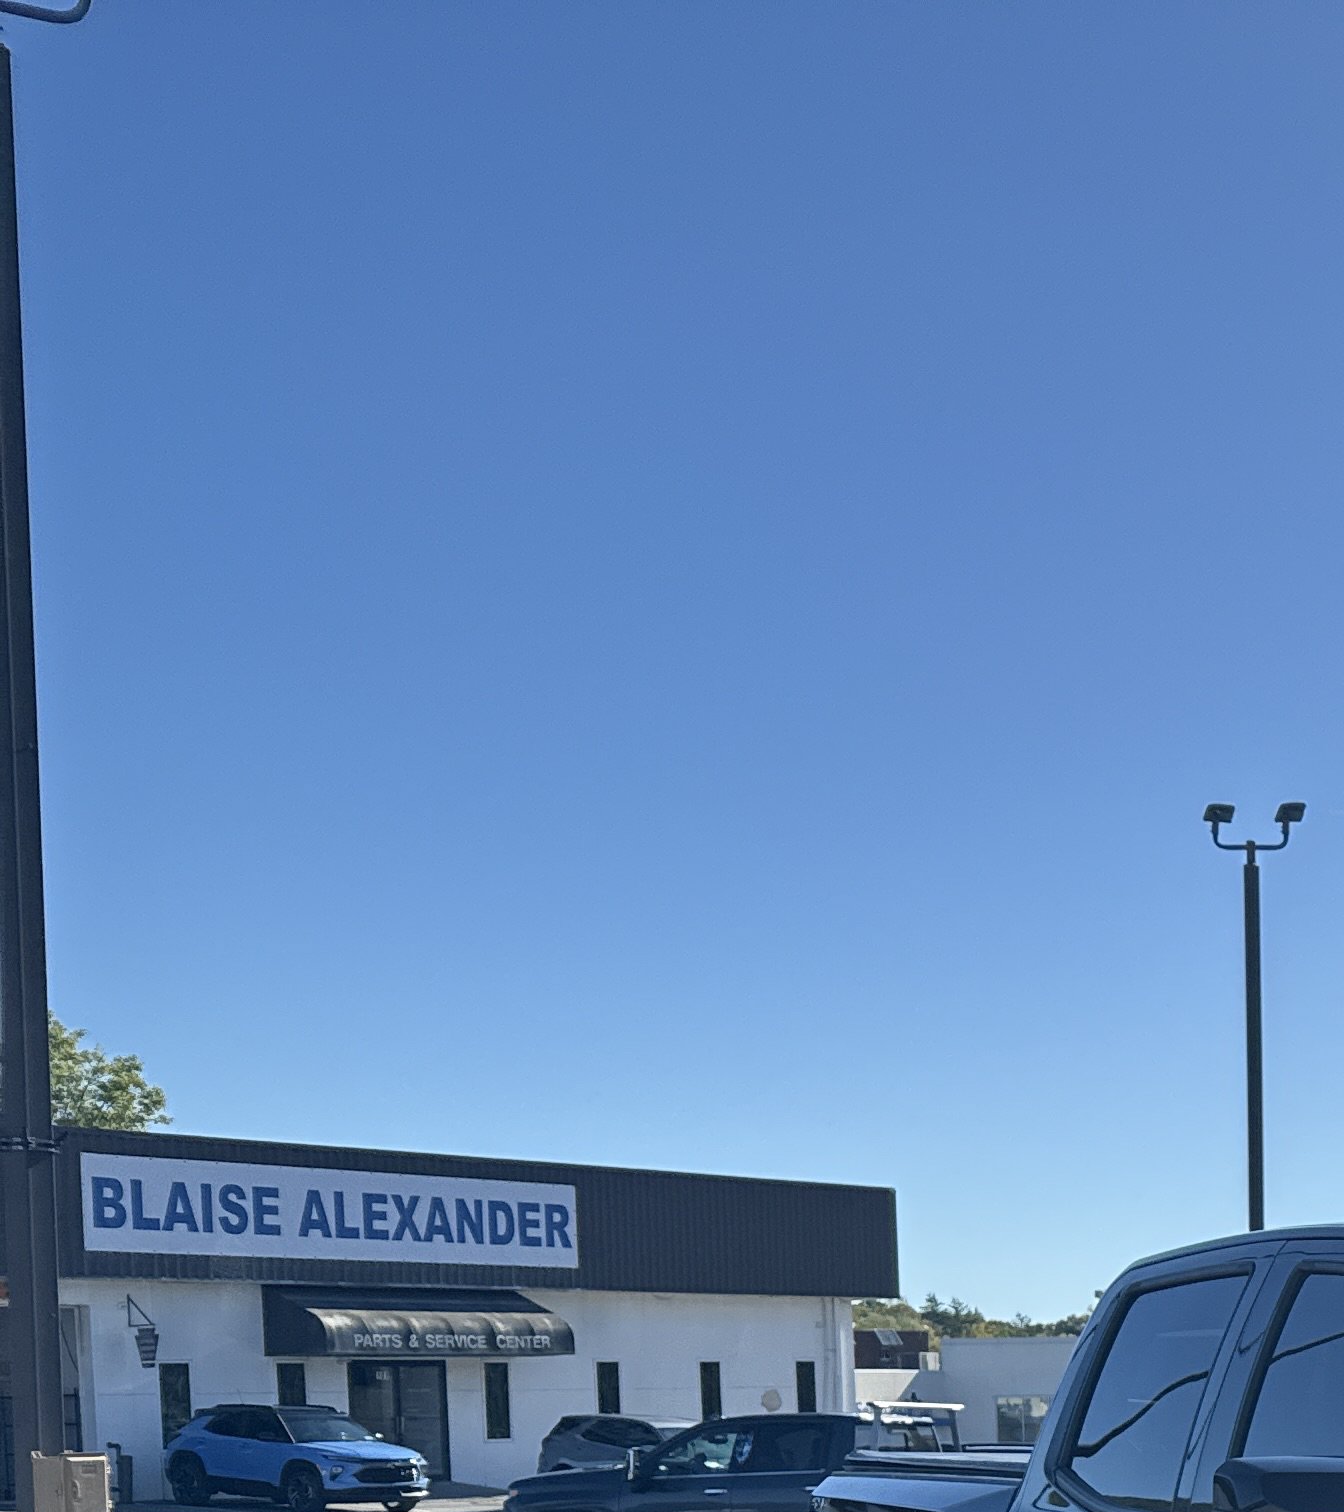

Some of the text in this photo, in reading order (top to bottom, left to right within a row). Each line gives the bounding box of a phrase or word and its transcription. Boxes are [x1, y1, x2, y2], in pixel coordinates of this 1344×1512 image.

[91, 1176, 573, 1249] BLAISE ALEXANDER
[354, 1333, 551, 1349] PARTS & SERVICE CENTER
